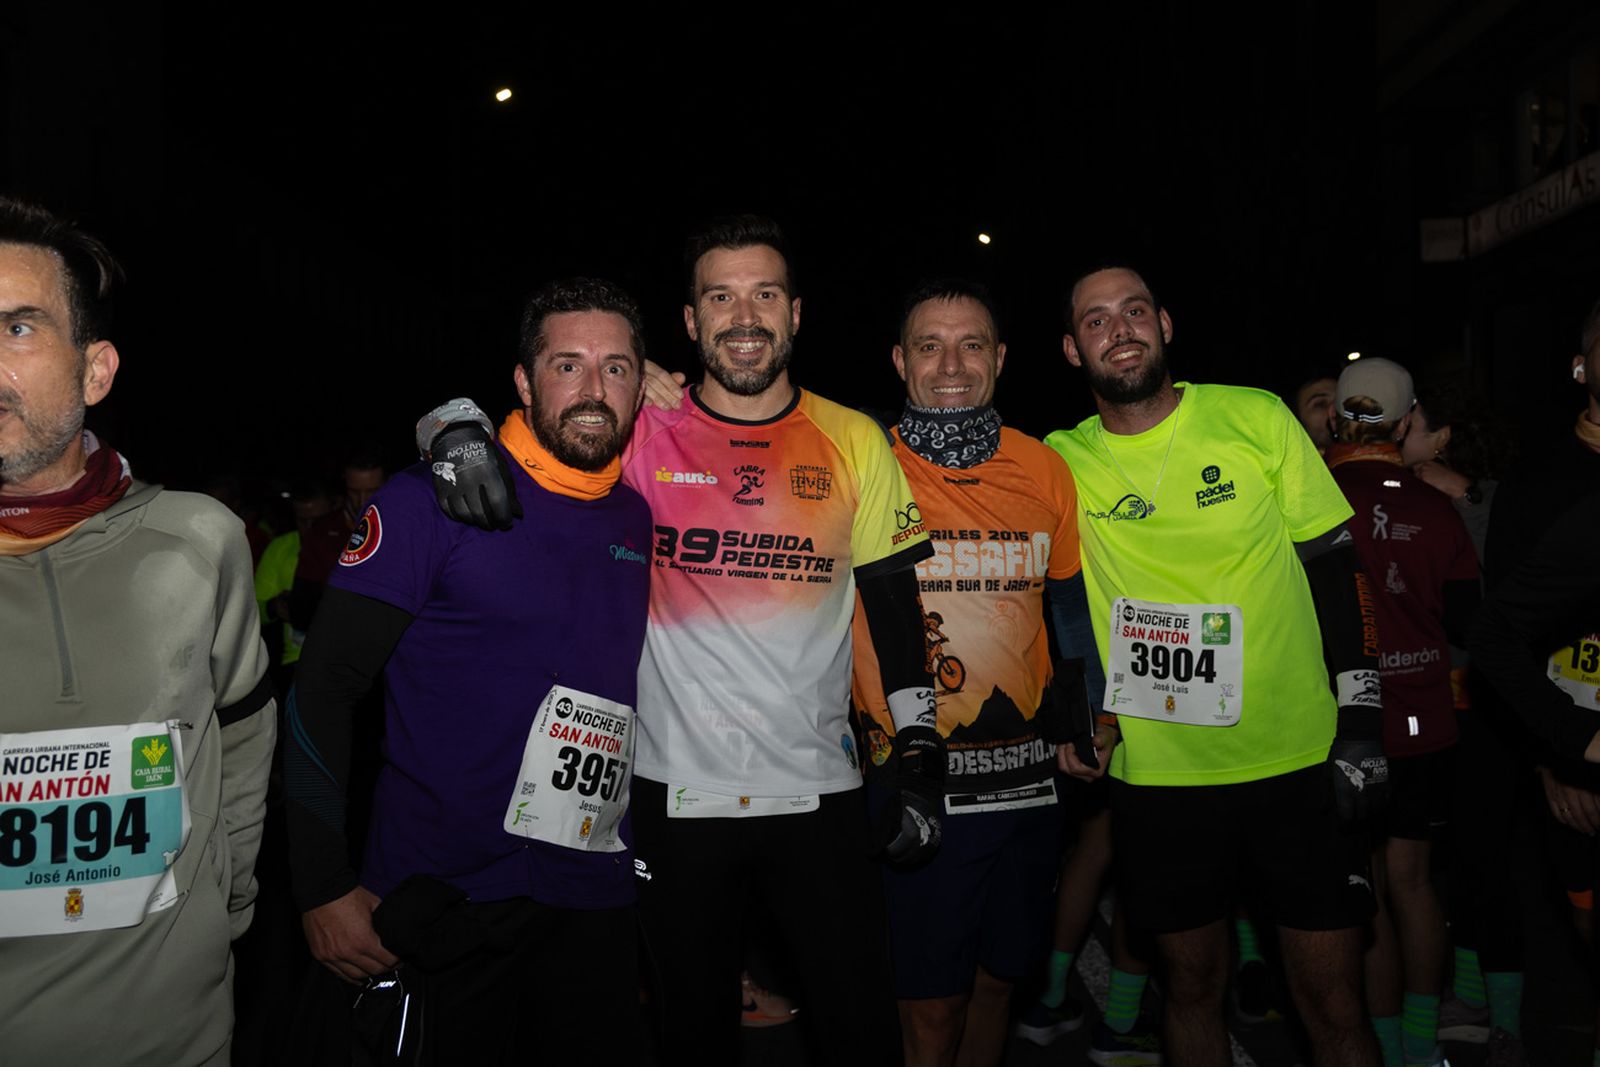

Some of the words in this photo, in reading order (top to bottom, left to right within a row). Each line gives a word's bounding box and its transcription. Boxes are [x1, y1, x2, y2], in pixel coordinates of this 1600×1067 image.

[656, 466, 718, 485] isauto
[733, 465, 766, 477] CABRA
[732, 496, 765, 507] running
[1197, 492, 1237, 509] nuestro
[655, 525, 720, 563] 39
[722, 530, 815, 553] SUBIDA
[721, 550, 836, 573] PEDESTRE
[727, 569, 768, 580] VIRGEN
[772, 572, 787, 581] DE
[791, 574, 803, 582] LA
[957, 580, 981, 592] SUR
[986, 580, 1000, 591] DE
[1004, 575, 1031, 592] JAÉN
[1136, 613, 1172, 628] NOCHE
[1174, 618, 1190, 629] DE
[1122, 625, 1146, 640] SAN
[1148, 628, 1190, 645] ANTÓN
[1130, 641, 1216, 684] 3904
[1379, 648, 1440, 669] lderón
[1152, 681, 1170, 693] José
[1172, 686, 1189, 694] Luis
[556, 701, 572, 715] 43
[572, 709, 614, 733] NOCHE
[614, 721, 627, 737] DE
[3, 748, 34, 756] CARRERA
[35, 745, 61, 754] URBANA
[63, 741, 110, 751] INTERNACIONAL
[549, 722, 582, 744] SAN
[582, 731, 622, 755] ANTÓN
[3, 752, 79, 775] NOCHE
[84, 750, 111, 770] DE
[551, 745, 628, 803] 3957
[0, 781, 23, 803] N
[28, 770, 111, 802] ANTÓN
[0, 797, 150, 868] 8194
[25, 869, 61, 886] José
[66, 864, 121, 882] Antonio
